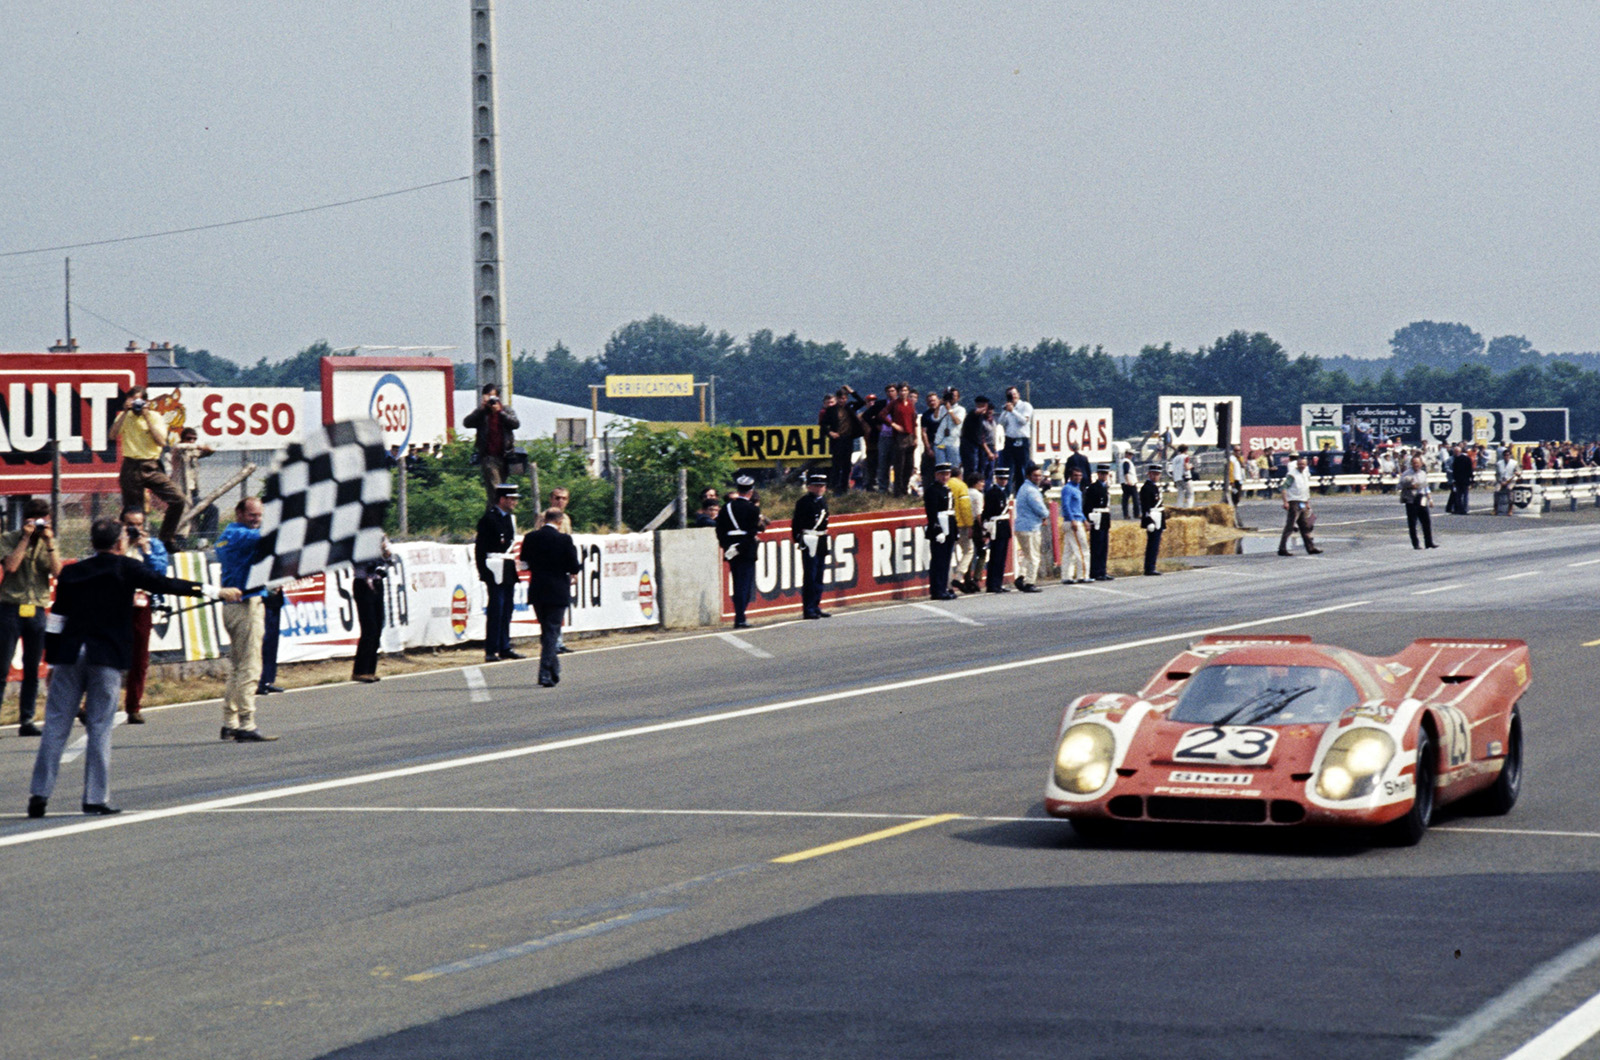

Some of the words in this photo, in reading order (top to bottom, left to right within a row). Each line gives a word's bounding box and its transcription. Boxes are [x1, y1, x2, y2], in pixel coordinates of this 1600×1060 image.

[611, 382, 688, 395] VERIFICATIONS
[1433, 423, 1451, 436] BP
[1472, 411, 1526, 442] BP
[1036, 418, 1107, 452] LUCAS
[730, 428, 831, 459] ARDAH
[1249, 437, 1298, 451] super
[1513, 489, 1532, 503] BP
[1175, 727, 1273, 759] 23
[1175, 773, 1249, 783] Shell
[1153, 786, 1261, 796] PORSCHE
